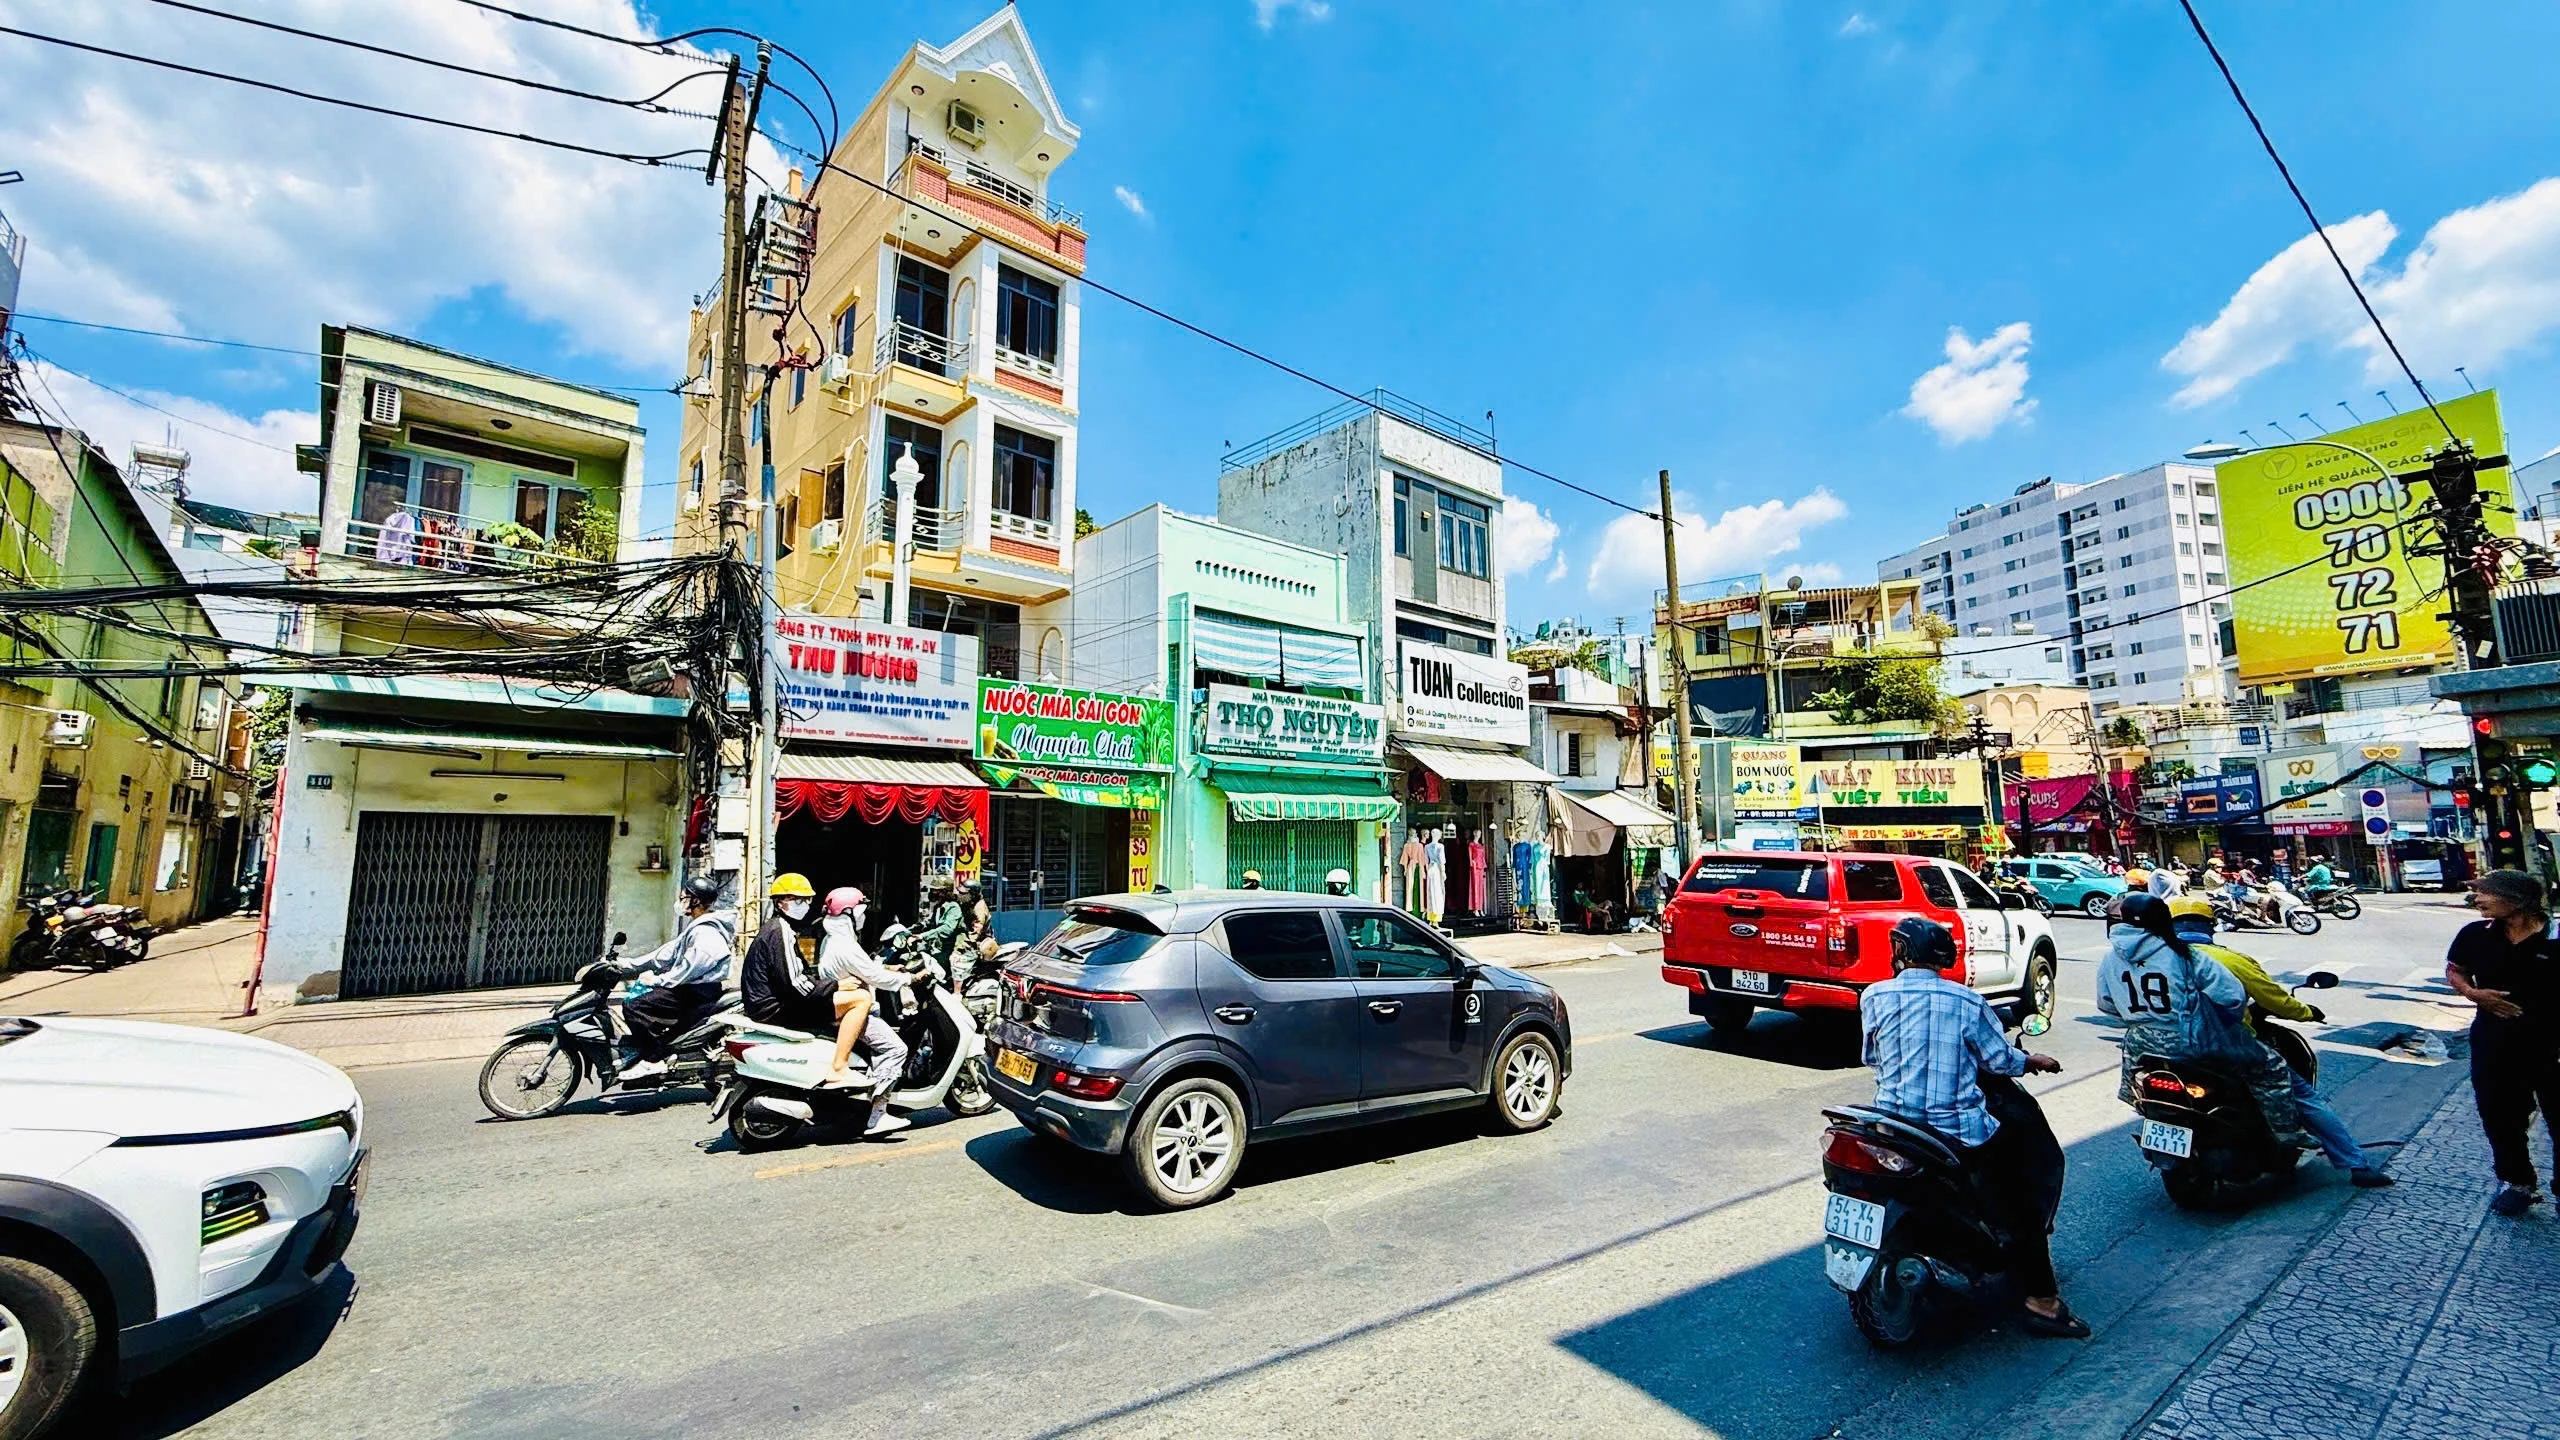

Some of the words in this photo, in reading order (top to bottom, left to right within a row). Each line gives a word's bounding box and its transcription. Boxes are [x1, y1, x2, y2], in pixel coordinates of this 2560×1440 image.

[2278, 479, 2304, 496] LIÊN
[2307, 475, 2325, 489] HỆ
[2329, 464, 2382, 483] QUẢNG
[2295, 478, 2411, 529] 0908
[2324, 524, 2391, 568] 70
[2329, 567, 2397, 611] 72
[810, 625, 825, 639] TY
[830, 627, 861, 643] TNHH
[866, 633, 891, 648] MTV
[2337, 611, 2400, 654] 71
[789, 644, 836, 674] THU
[843, 651, 918, 682] HƯƠNG
[1410, 656, 1453, 699] TUAN
[1457, 682, 1524, 710] Collection
[985, 685, 1037, 714] NƯỚC
[1040, 690, 1071, 719] MÍA
[1076, 693, 1102, 722] SÀI
[1106, 697, 1141, 725] GÒN
[1252, 692, 1267, 702] NHÀ
[1271, 694, 1295, 706] THUỐC
[1217, 701, 1274, 735] THỌ
[1283, 708, 1379, 740] NGUYÊN
[1012, 723, 1090, 761] Nguyên
[1094, 730, 1136, 760] Chất
[1743, 751, 1787, 761] QUANG
[1081, 769, 1100, 785] SÀI
[1102, 770, 1129, 786] GÒN
[1765, 763, 1795, 777] NƯỚC
[1820, 760, 1872, 785] MẮT
[1895, 762, 1956, 785] KÍNH
[1832, 789, 1882, 806] VIỆT
[1897, 785, 1948, 804] TIẾN
[2226, 801, 2251, 811] Dulux
[1863, 829, 1889, 839] 20%
[1761, 931, 1780, 940] 1800
[1782, 933, 1792, 941] 54
[1794, 934, 1804, 942] 54
[1806, 935, 1817, 943] 83
[2121, 970, 2172, 1014] 18
[2145, 1135, 2187, 1154] 041.11
[2151, 1123, 2185, 1142] 59-P2
[1835, 1198, 1874, 1223] 54-X4
[1831, 1216, 1873, 1242] 3110
